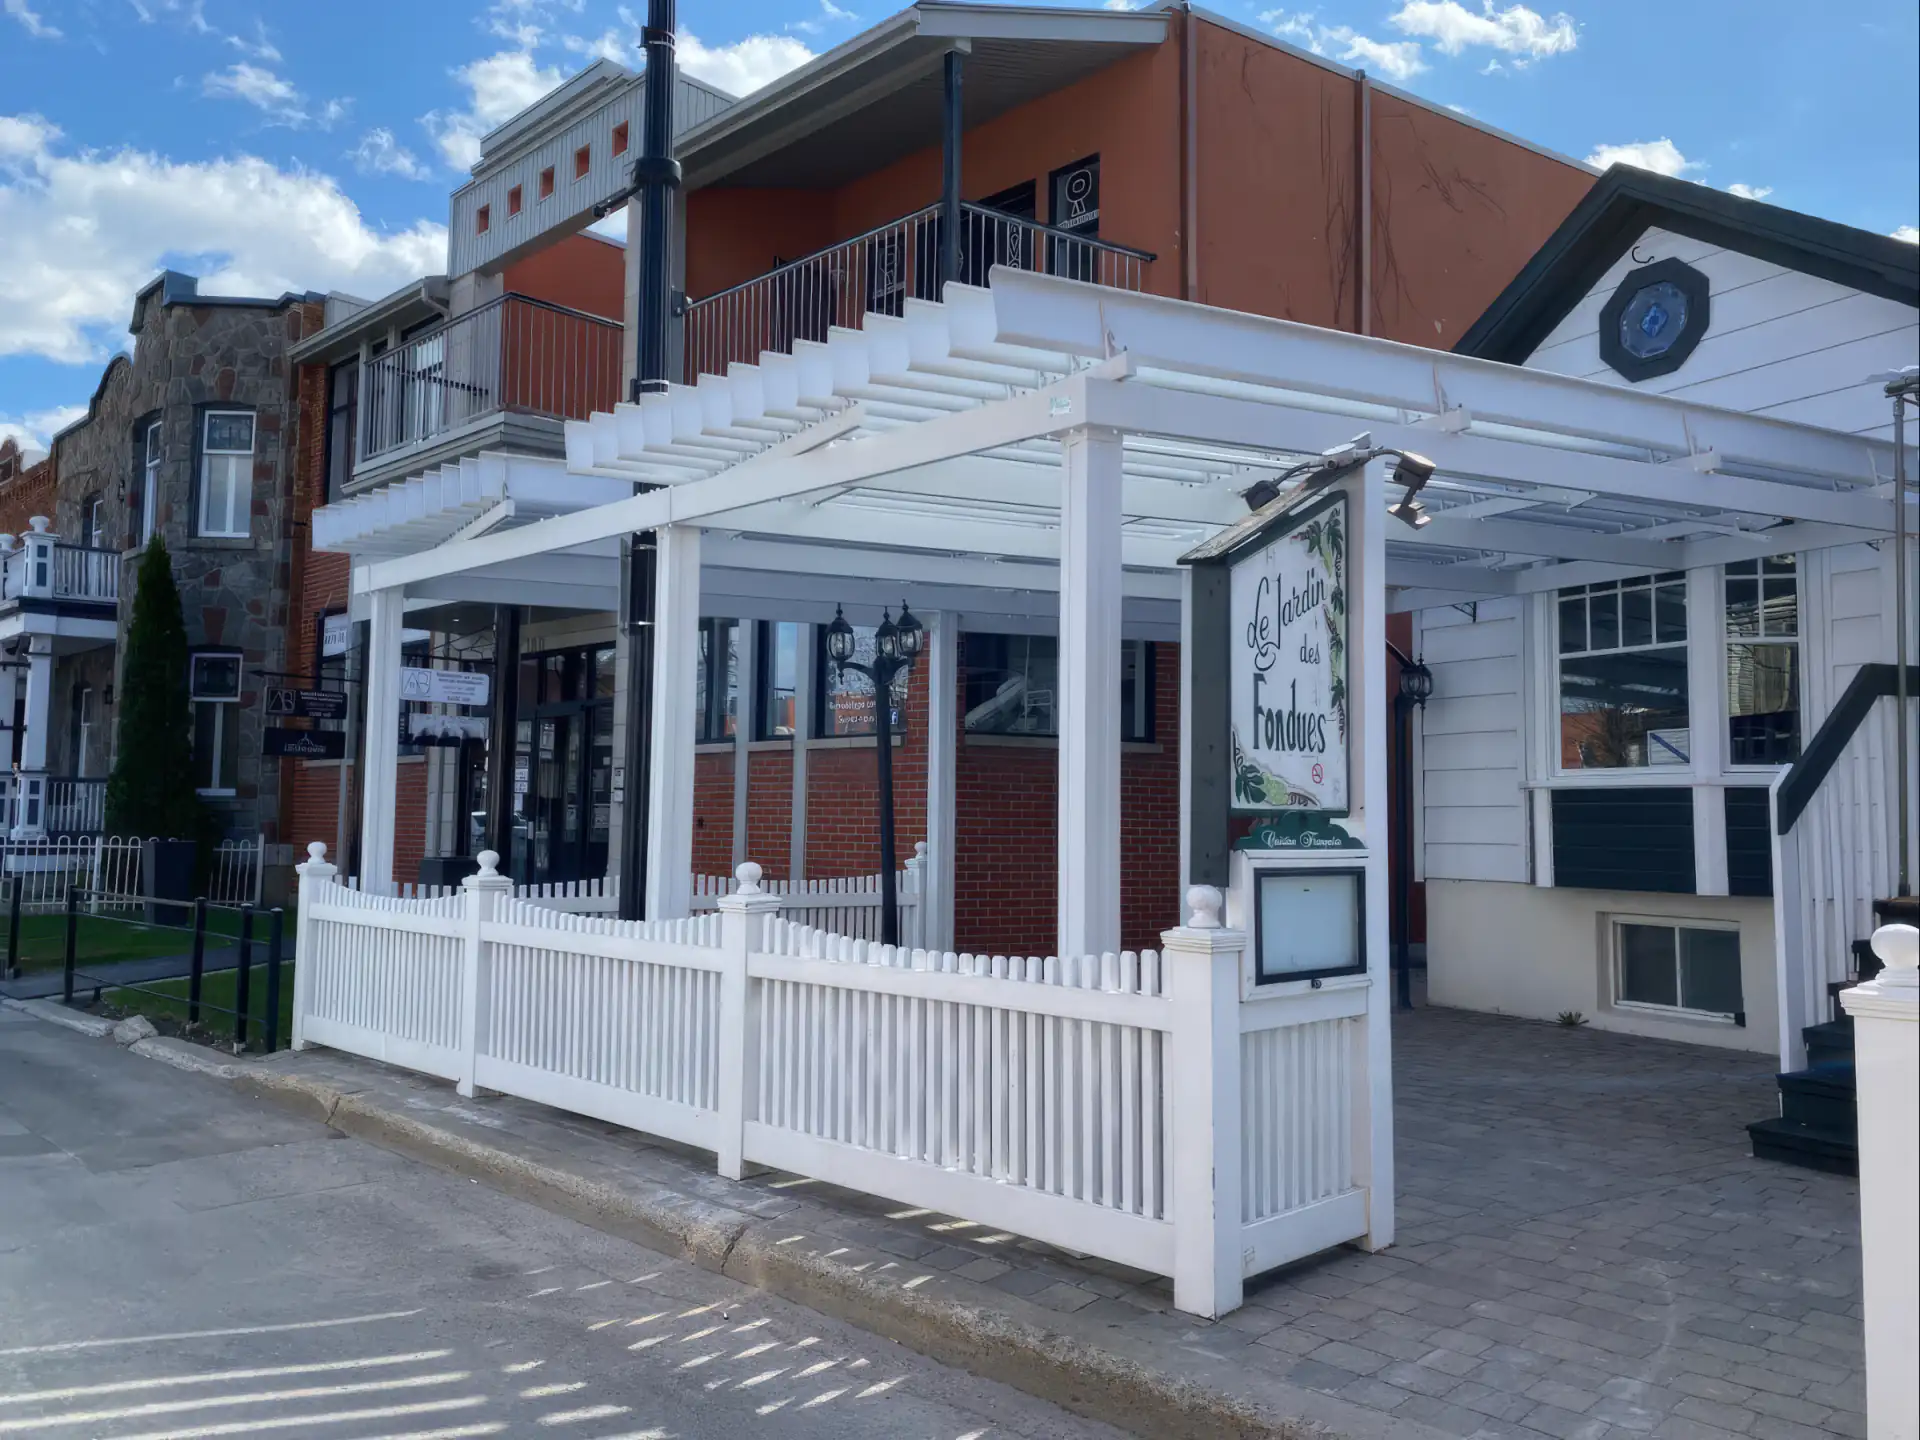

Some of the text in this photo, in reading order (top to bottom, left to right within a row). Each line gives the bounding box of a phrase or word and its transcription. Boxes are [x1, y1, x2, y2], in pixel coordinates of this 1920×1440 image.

[1247, 567, 1327, 670] Le Jardin
[1300, 633, 1321, 664] des
[1252, 672, 1327, 754] Fondues
